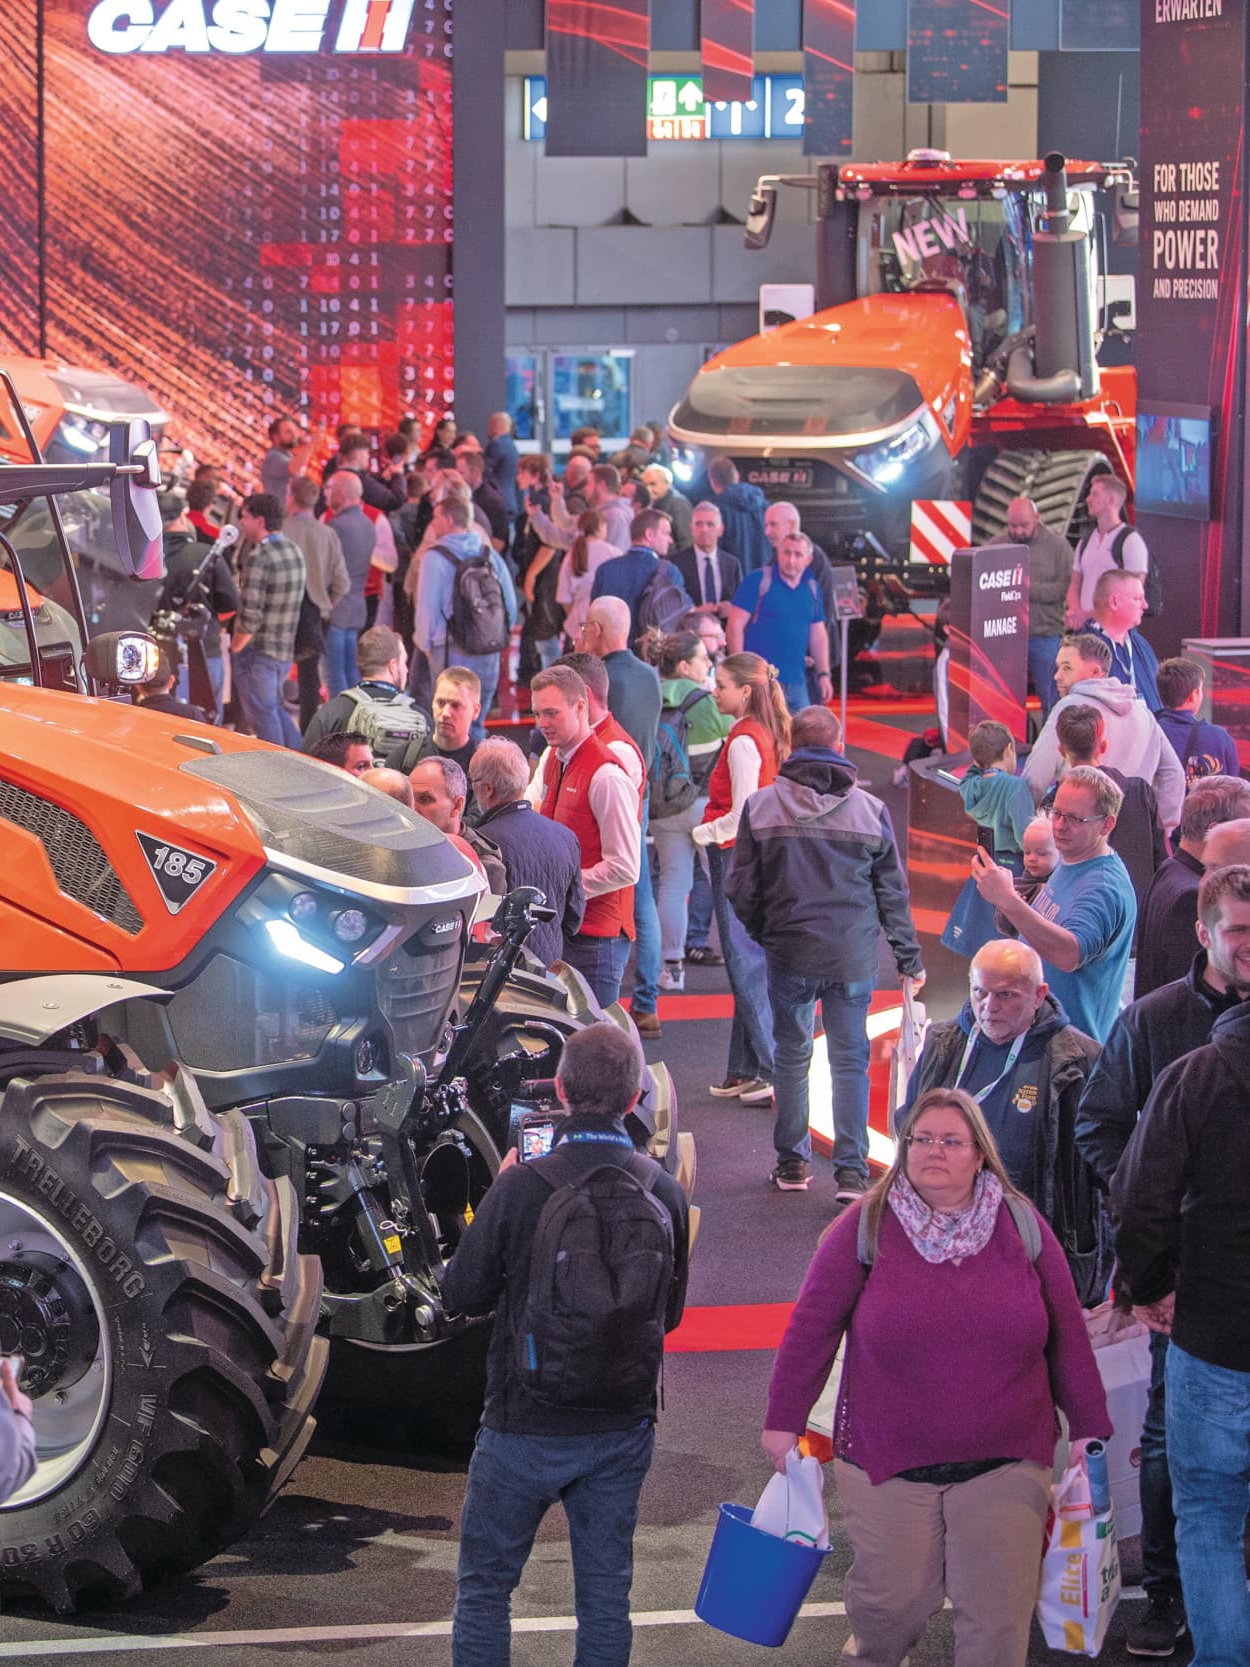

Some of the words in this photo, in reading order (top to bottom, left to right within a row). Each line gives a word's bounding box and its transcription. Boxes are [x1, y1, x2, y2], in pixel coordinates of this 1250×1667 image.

[87, 0, 328, 53] CASE
[1155, 0, 1222, 23] ERWARTEN
[784, 88, 805, 124] 2
[1154, 164, 1176, 192] FOR
[1179, 161, 1220, 191] THOSE
[1154, 200, 1176, 222] WHO
[1179, 199, 1219, 222] DEMAND
[892, 208, 969, 265] NEW
[1153, 229, 1219, 269] POWER
[1153, 278, 1171, 299] AND
[1172, 278, 1219, 299] PRECISION
[979, 570, 1012, 590] CASE
[984, 616, 1018, 638] MANAGE
[153, 846, 206, 884] 185
[10, 1133, 146, 1299] TRELLEBORG
